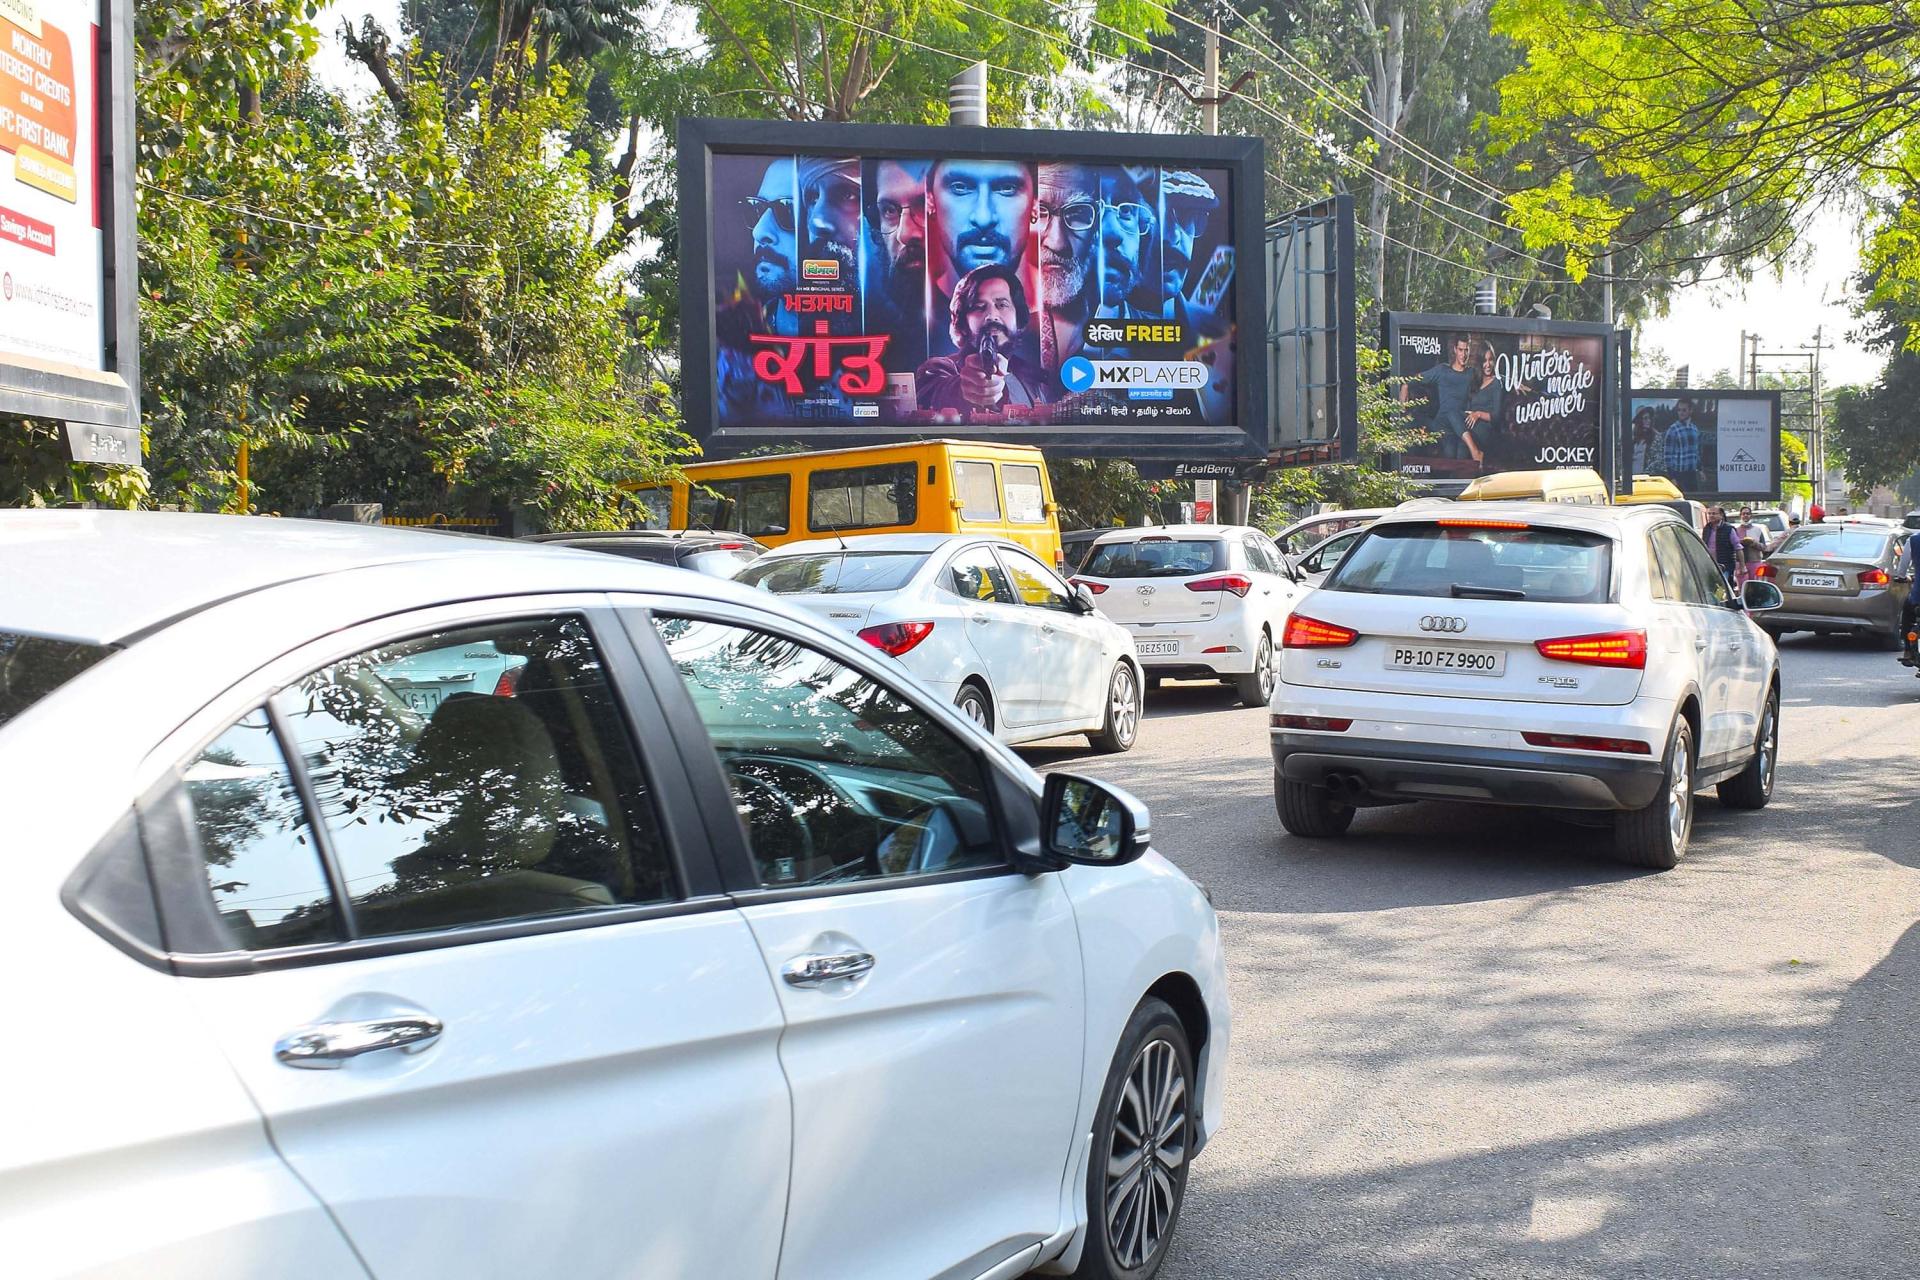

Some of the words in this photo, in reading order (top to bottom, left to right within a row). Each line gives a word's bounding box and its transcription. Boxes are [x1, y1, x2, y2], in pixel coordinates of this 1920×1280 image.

[0, 0, 33, 21] DUCING
[12, 30, 52, 71] MONTHLY
[0, 49, 34, 87] TEREST
[35, 70, 70, 108] CREDITS
[0, 105, 15, 133] FC
[16, 113, 43, 146] FIRST
[43, 127, 70, 159] BANK
[0, 214, 27, 241] Savings
[27, 225, 53, 248] Account
[1088, 324, 1123, 342] देखिए
[1126, 325, 1181, 342] FREE!
[1400, 335, 1440, 346] THERMAL
[1414, 344, 1441, 355] WEAR
[1495, 347, 1573, 392] Winters
[1547, 362, 1594, 396] made
[1111, 405, 1128, 417] हिन्दी
[1516, 389, 1586, 424] warmer
[1534, 447, 1595, 463] JOCKEY
[1184, 464, 1236, 476] LeafBerry
[1719, 464, 1744, 472] MONTE
[1744, 464, 1766, 472] CARLO
[1136, 643, 1177, 653] 10EZ5100
[1394, 649, 1433, 666] PB-10
[1436, 651, 1455, 668] FZ
[1457, 653, 1496, 670] 9900
